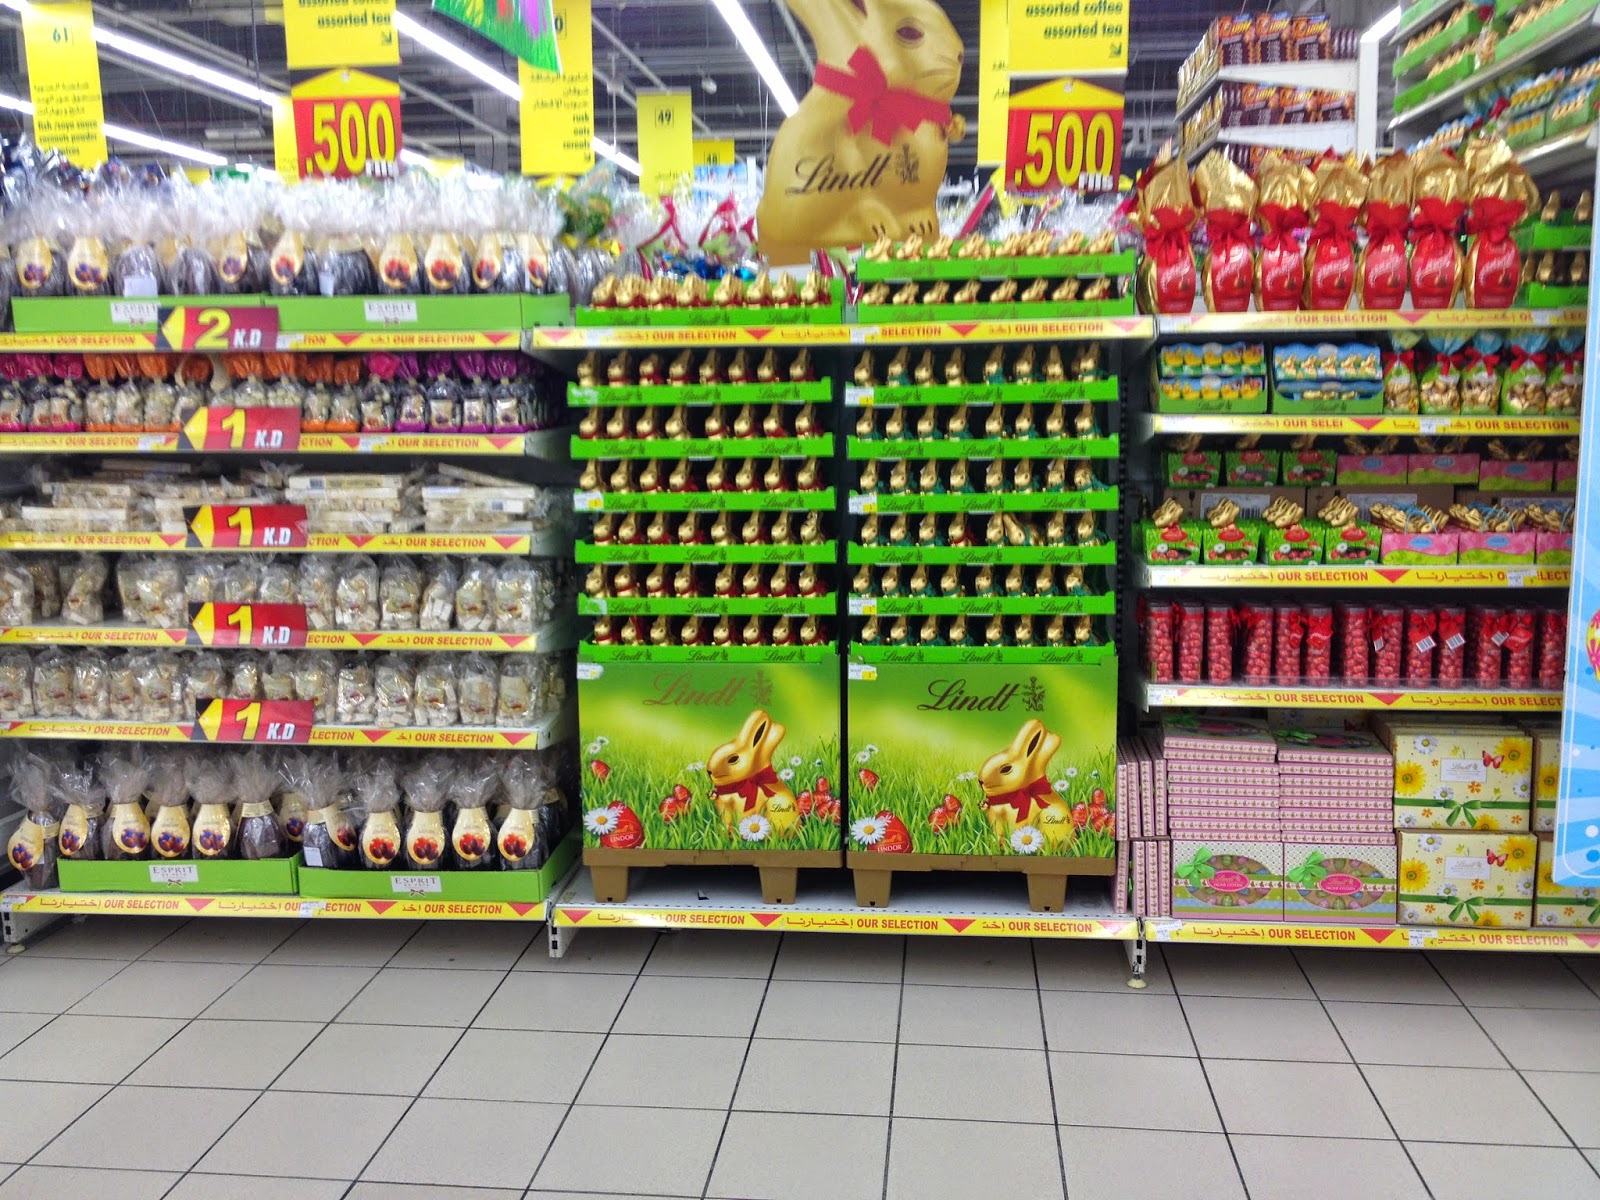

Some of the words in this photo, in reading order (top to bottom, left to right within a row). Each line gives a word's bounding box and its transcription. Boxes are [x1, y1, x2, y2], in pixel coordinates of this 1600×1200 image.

[1026, 0, 1080, 17] assorted
[1084, 0, 1122, 15] coffee
[317, 11, 368, 28] assorted
[372, 12, 391, 23] tea
[53, 27, 68, 43] 61
[1044, 20, 1098, 39] assorted
[1102, 22, 1122, 35] tea
[657, 110, 672, 125] 49
[1014, 111, 1115, 187] .500
[785, 152, 893, 196] Lindt
[1294, 314, 1318, 323] OUR
[1322, 313, 1388, 323] SELECTION
[194, 308, 232, 349] 2
[881, 327, 941, 338] SELECTION
[1015, 324, 1038, 334] OUR
[1042, 322, 1104, 334] SELECTION
[57, 335, 78, 345] OUR
[81, 335, 136, 346] SELECTION
[233, 328, 262, 348] K.D
[393, 334, 414, 344] OUR
[418, 334, 475, 345] SELECTION
[652, 332, 676, 341] OUR
[678, 330, 737, 341] SELECTION
[221, 408, 246, 449] 1
[1311, 419, 1342, 429] SELE
[1474, 420, 1500, 430] OUR
[1503, 420, 1569, 430] SELECTION
[89, 435, 139, 446] SELECTIO
[254, 429, 283, 448] K.D
[301, 437, 333, 447] CTION
[398, 437, 419, 447] OUR
[422, 437, 479, 448] SELECTION
[607, 497, 641, 509] Lindt
[685, 497, 720, 509] Lindt
[763, 496, 798, 508] Lindt
[882, 499, 918, 511] Lindt
[962, 498, 998, 510] Lindt
[1043, 497, 1079, 509] Lindt
[227, 506, 254, 546] 1
[75, 535, 95, 544] OUR
[98, 535, 151, 545] SELECTION
[263, 527, 292, 545] K.D
[309, 537, 339, 547] CTION
[405, 538, 426, 547] OUR
[430, 538, 486, 547] SELECTION
[609, 550, 642, 561] Lindt
[686, 550, 721, 561] Lindt
[764, 550, 799, 561] Lindt
[881, 550, 917, 562] Lindt
[961, 550, 997, 562] Lindt
[1041, 550, 1077, 562] Lindt
[1278, 571, 1302, 581] OUR
[1305, 571, 1369, 582] SELECTION
[610, 602, 643, 614] Lindt
[687, 602, 722, 613] Lindt
[764, 602, 799, 613] Lindt
[881, 601, 918, 613] Lindt
[961, 601, 997, 613] Lindt
[1041, 600, 1077, 613] Lindt
[227, 605, 253, 644] 1
[81, 631, 102, 640] OUR
[105, 631, 158, 641] SELECTION
[263, 626, 291, 644] K.D
[307, 634, 345, 644] ECTION
[412, 635, 434, 645] OUR
[437, 635, 493, 646] SELECTION
[611, 650, 645, 662] Lindt
[688, 650, 723, 662] Lindt
[765, 650, 800, 661] Lindt
[882, 651, 918, 662] Lindt
[960, 651, 996, 662] Lindt
[1040, 651, 1076, 662] Lindt
[642, 669, 748, 707] Lindt
[917, 678, 1020, 712] Lindt
[1274, 693, 1298, 703] OUR
[1301, 693, 1364, 704] SELECTION
[1491, 696, 1516, 706] OUR
[1519, 696, 1563, 707] SELECT
[235, 702, 262, 741] 1
[94, 725, 114, 734] OUR
[117, 725, 170, 736] SELECTION
[267, 722, 295, 740] K.D
[312, 731, 355, 741] LECTION
[415, 732, 436, 742] OUR
[438, 733, 494, 743] SELECTION
[770, 803, 793, 813] Lindt
[1044, 815, 1068, 825] Lindt
[609, 833, 635, 844] LINDOR
[877, 843, 902, 853] LINDOR
[152, 866, 194, 875] ESPRIT
[394, 877, 438, 886] ESPRIT
[104, 899, 124, 909] OUR
[127, 899, 179, 910] SELECTION
[325, 902, 361, 912] ECTION
[424, 904, 445, 914] OUR
[447, 904, 502, 914] SELECTION
[665, 914, 686, 924] OUR
[689, 914, 745, 925] SELECTION
[857, 918, 879, 928] OUR
[881, 919, 939, 930] SELECTION
[1008, 921, 1031, 931] OUR
[1033, 922, 1093, 933] SELECTION
[1268, 928, 1291, 939] OUR
[1295, 929, 1356, 941] SELECTION
[1479, 934, 1501, 944] OUR
[1506, 935, 1569, 946] SELECTION
